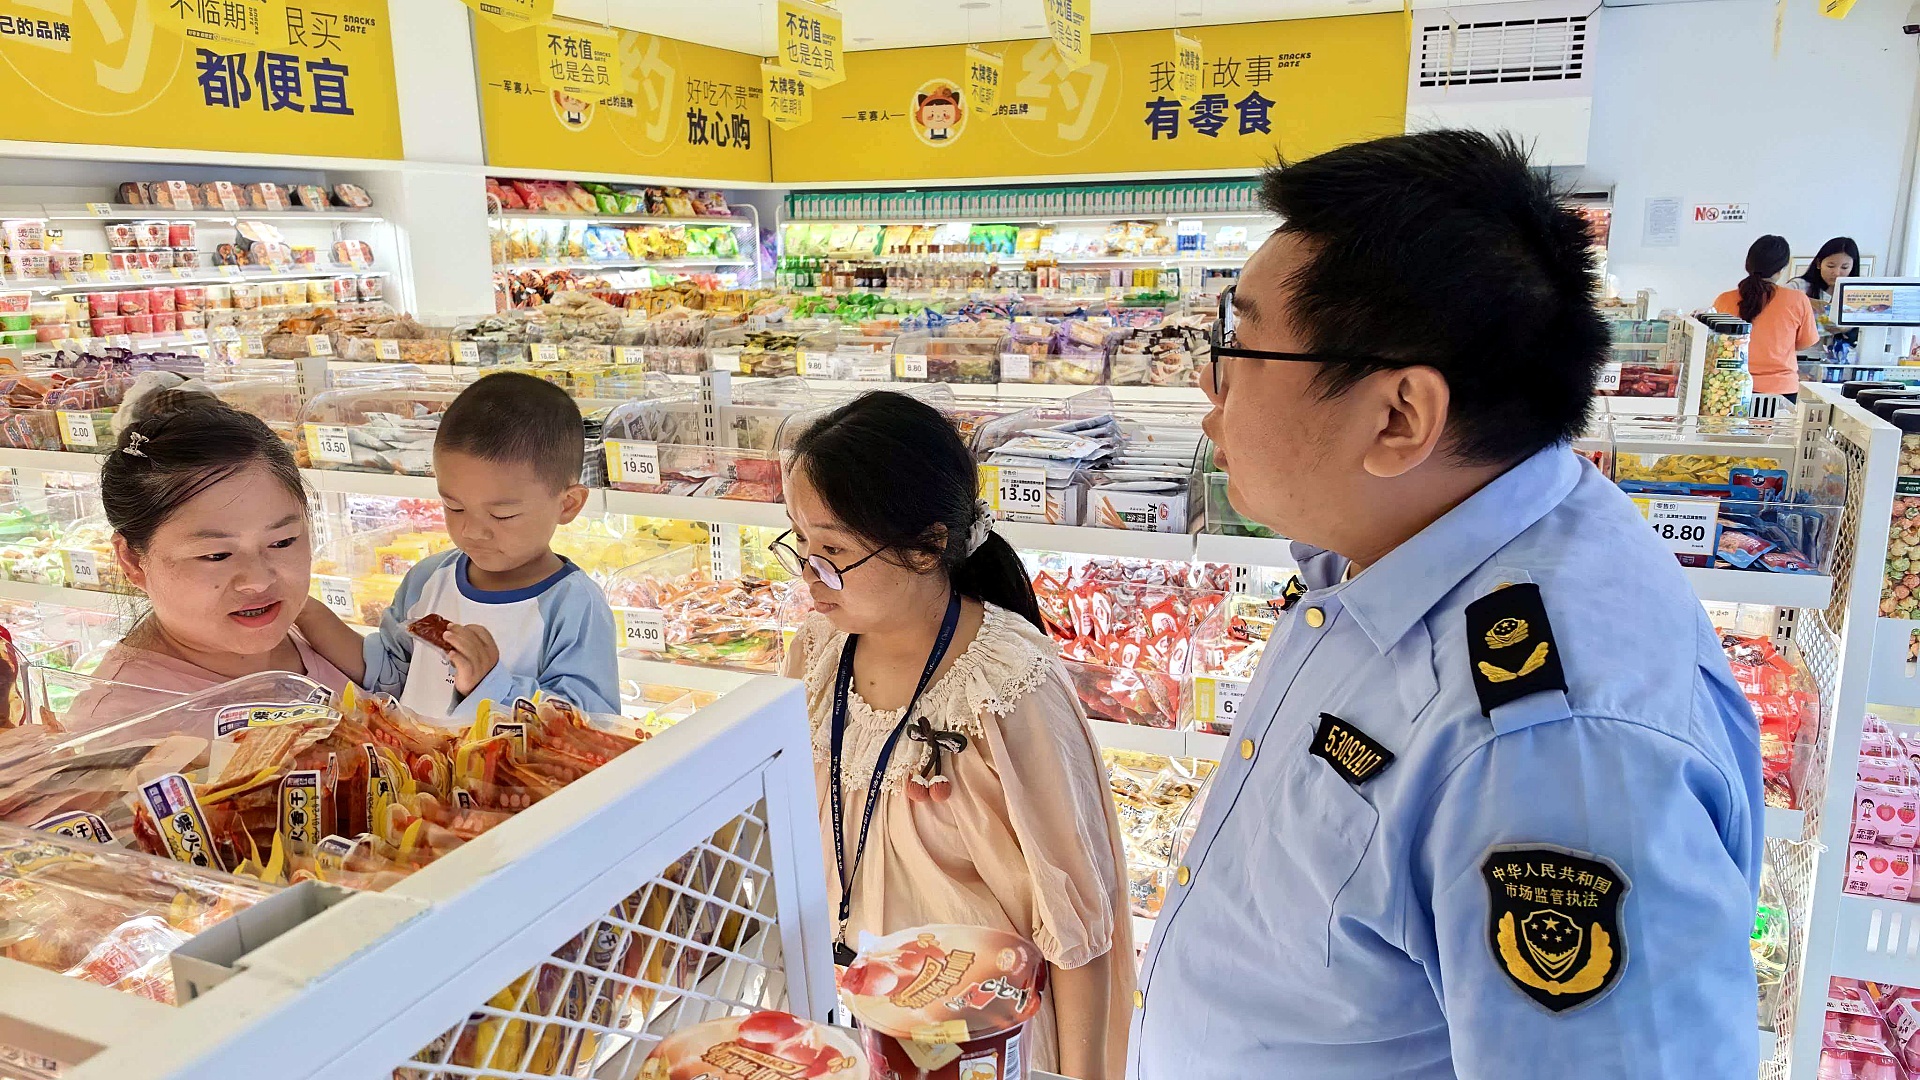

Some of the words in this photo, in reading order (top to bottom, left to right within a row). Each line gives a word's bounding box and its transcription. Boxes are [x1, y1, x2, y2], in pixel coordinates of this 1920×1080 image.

[343, 14, 376, 27] SNACKS
[786, 12, 822, 43] 不充值
[0, 15, 72, 42] 己的品牌
[344, 25, 367, 34] DATE
[547, 33, 593, 60] 不充值
[787, 39, 835, 72] 也是会员
[1278, 52, 1312, 60] SNACKS
[1277, 60, 1300, 68] DATE
[550, 59, 610, 86] 也是会员
[195, 47, 355, 116] 都便宜
[769, 76, 805, 97] 大牌零食
[687, 76, 748, 110] 好吃不贵
[1015, 38, 1109, 142] 约
[857, 110, 890, 122] 军赛人
[991, 103, 1029, 117] 的品牌
[1144, 90, 1277, 141] 有零食
[687, 107, 751, 150] 放心购
[807, 362, 822, 370] 9.80
[907, 364, 922, 372] 8.80
[1597, 375, 1616, 384] .80
[72, 427, 89, 438] 2.00
[320, 441, 346, 452] 13.50
[623, 461, 654, 475] 19.50
[999, 486, 1041, 502] 13.50
[1652, 523, 1705, 541] 18.80
[74, 565, 91, 576] 2.00
[326, 595, 347, 607] 9.90
[627, 627, 659, 640] 24.90
[1223, 700, 1241, 714] 6.
[290, 790, 306, 846] 火香干
[1492, 862, 1613, 895] 中华人民共和国
[1504, 882, 1600, 908] 市场监管执法
